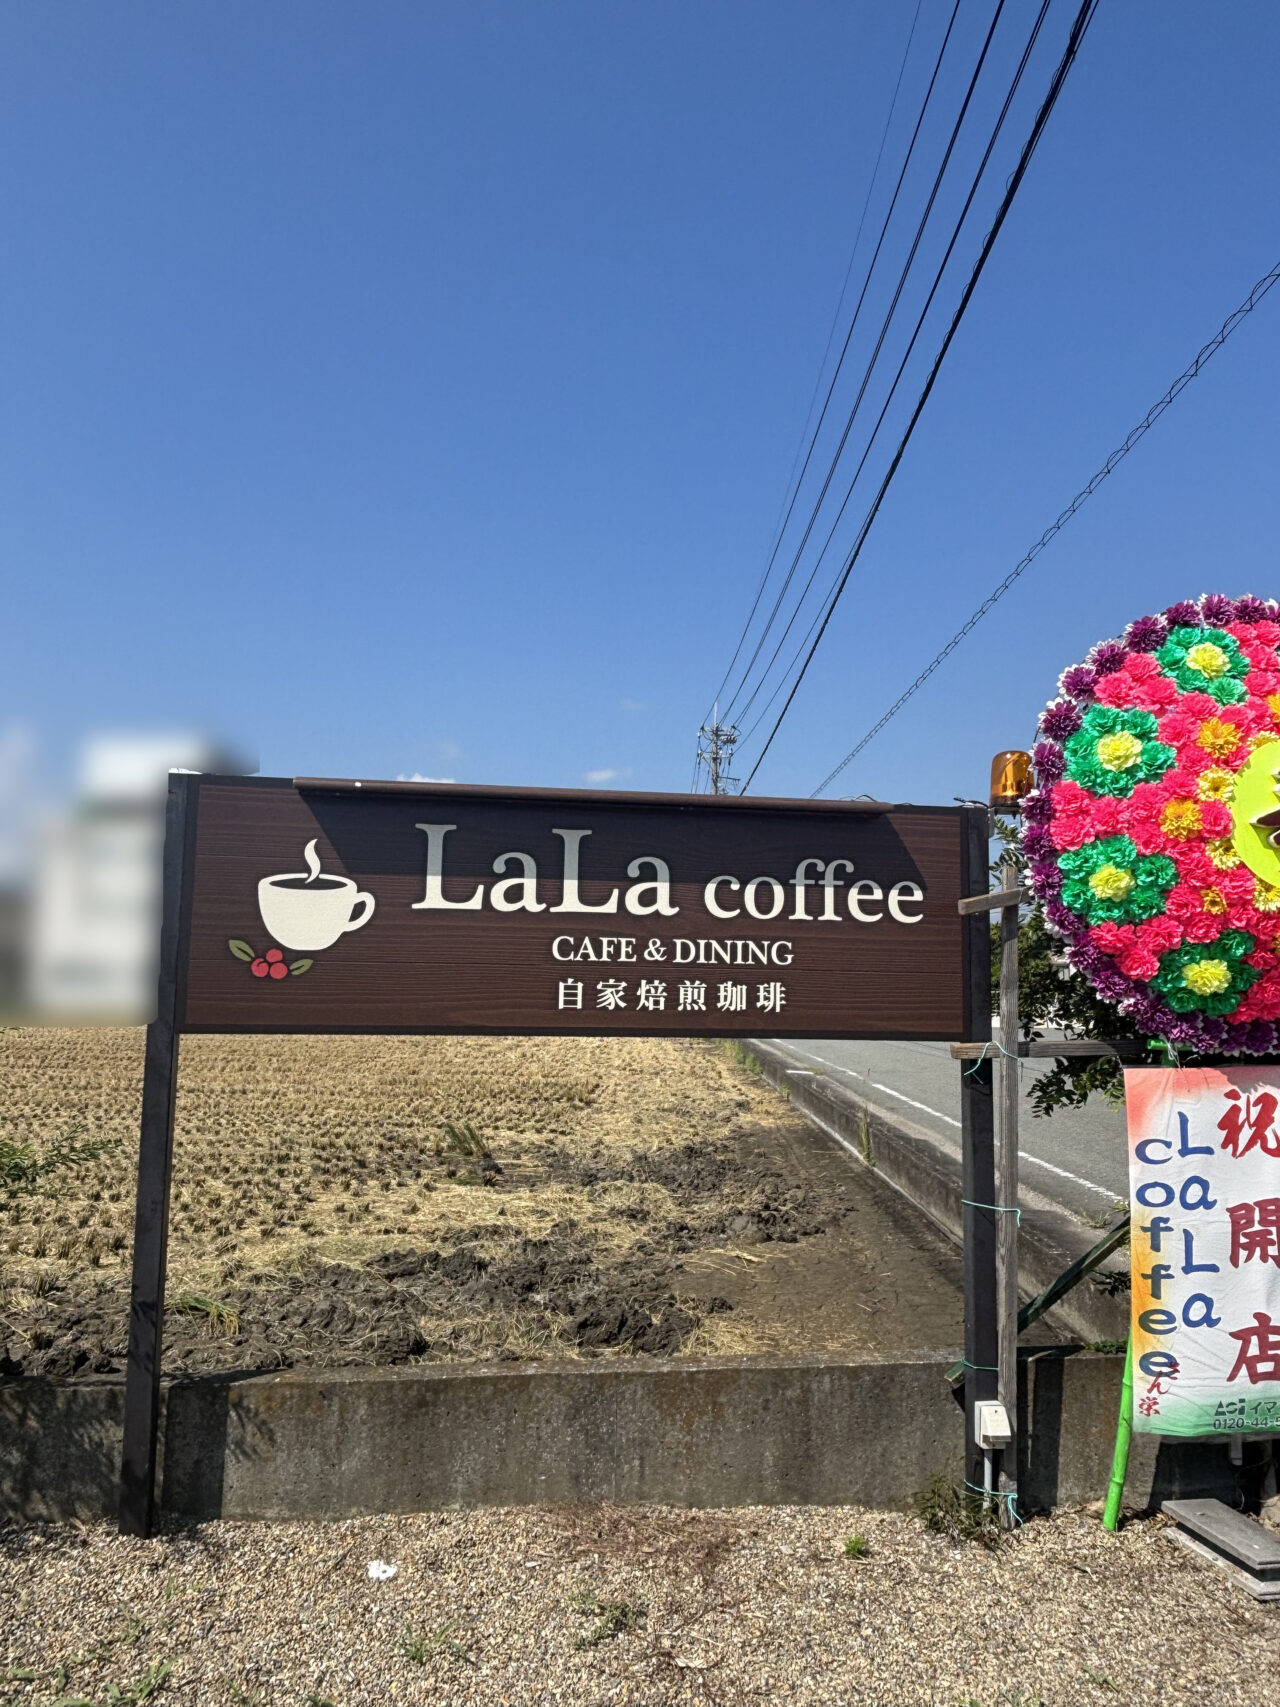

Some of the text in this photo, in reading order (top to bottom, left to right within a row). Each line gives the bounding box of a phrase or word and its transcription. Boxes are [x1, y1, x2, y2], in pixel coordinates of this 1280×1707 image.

[411, 823, 924, 924] LaLa coffee
[552, 936, 794, 965] CAFE & DINING
[557, 977, 787, 1013] 自家焙煎珈琲
[1135, 1139, 1178, 1377] coffee
[1177, 1111, 1222, 1328] LaLa
